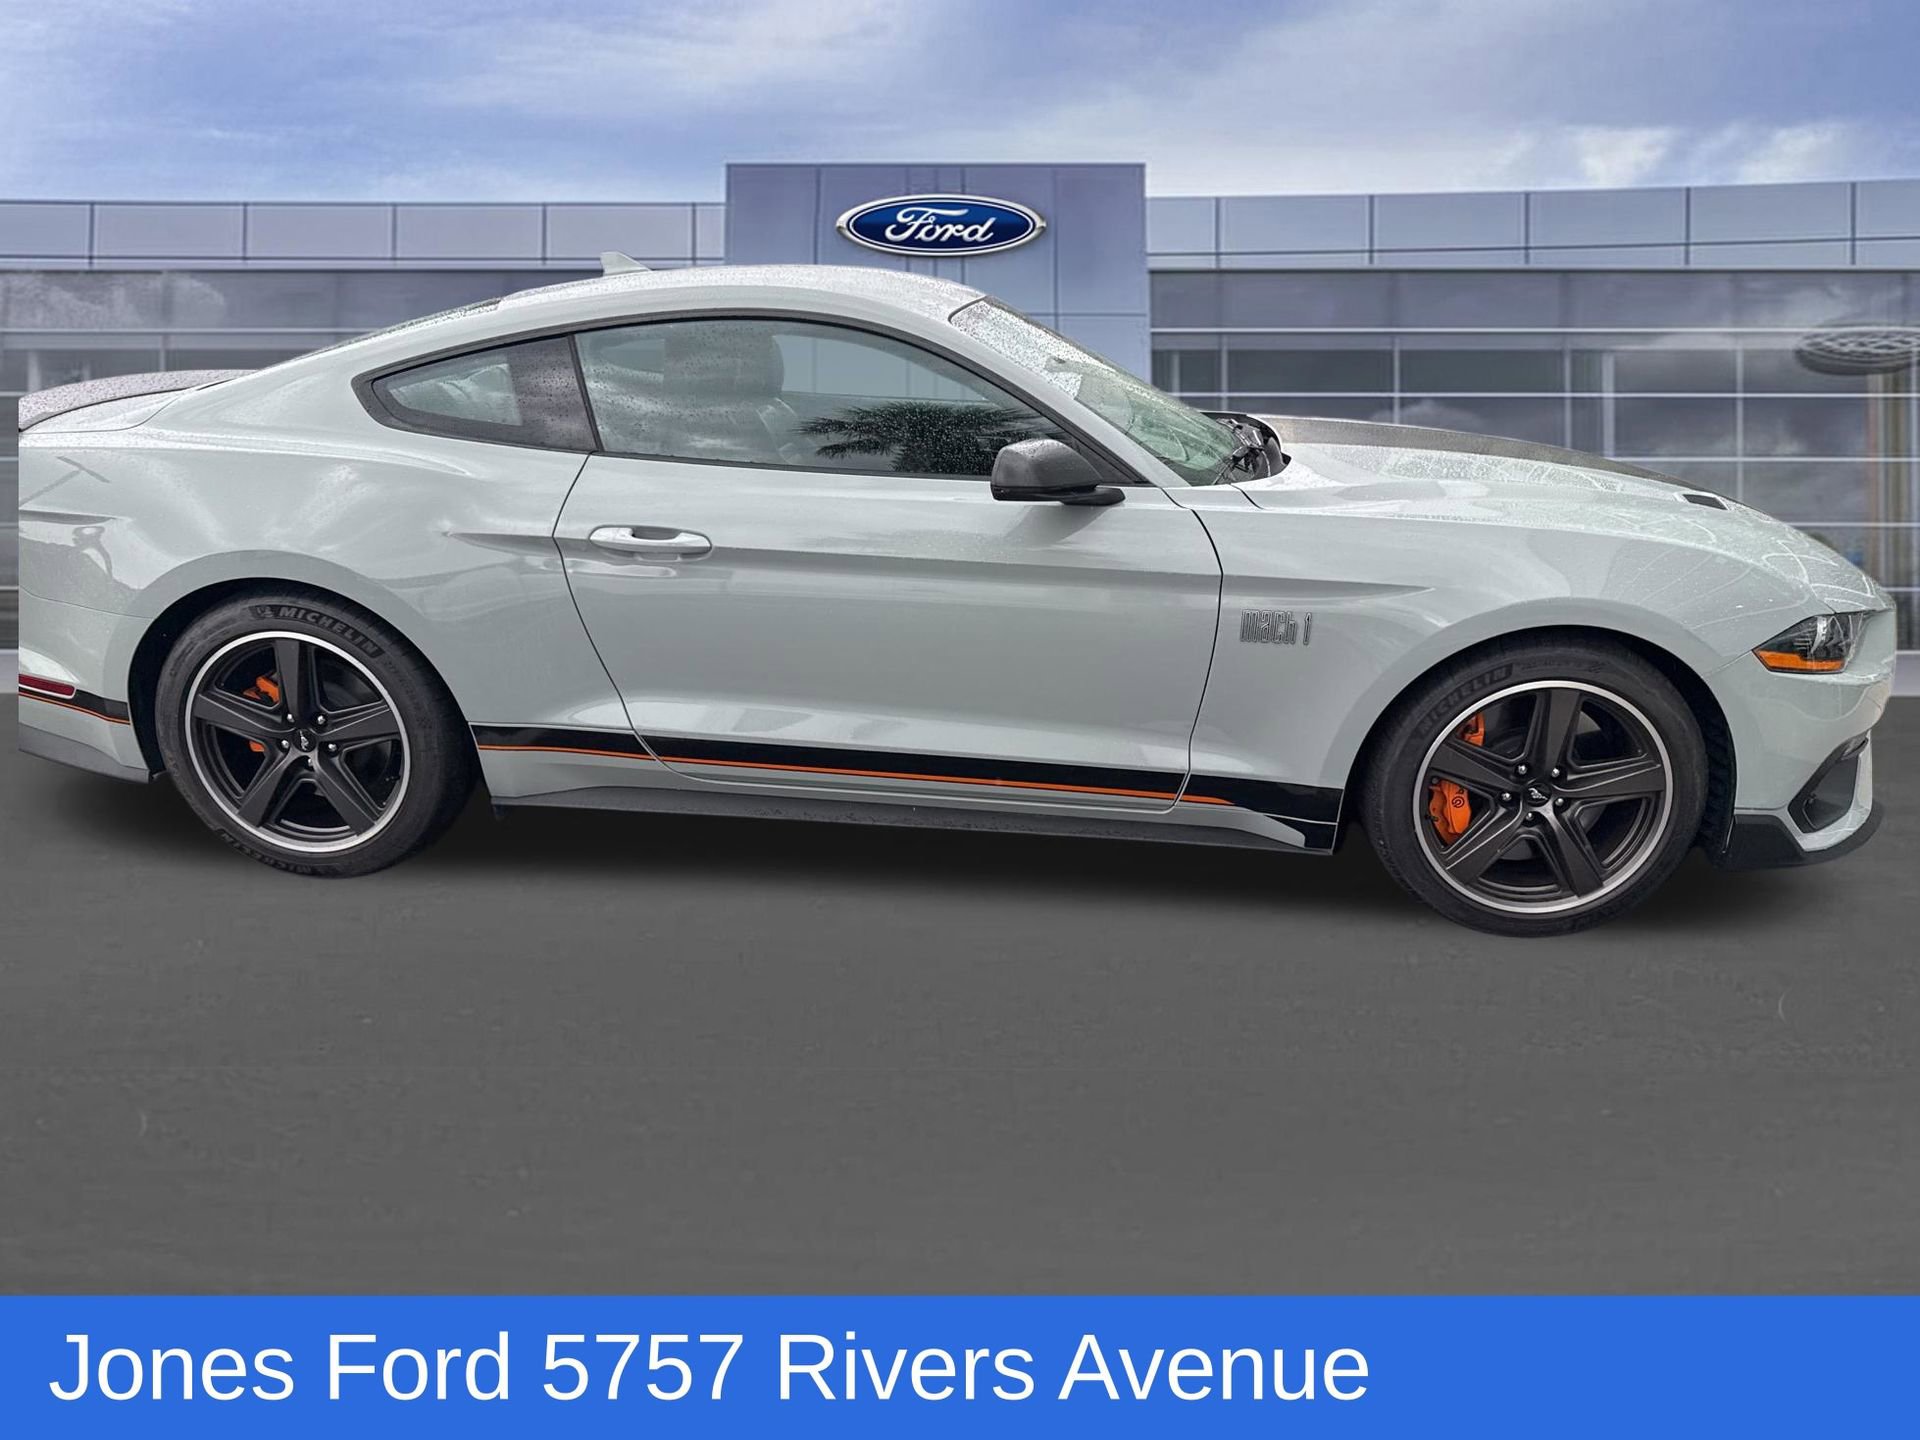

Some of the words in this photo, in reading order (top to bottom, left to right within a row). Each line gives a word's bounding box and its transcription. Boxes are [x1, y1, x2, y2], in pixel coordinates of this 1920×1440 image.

[885, 207, 996, 242] Ford
[279, 606, 383, 657] MICHELIN
[1303, 612, 1312, 645] 1
[1417, 665, 1511, 735] MICHELIN
